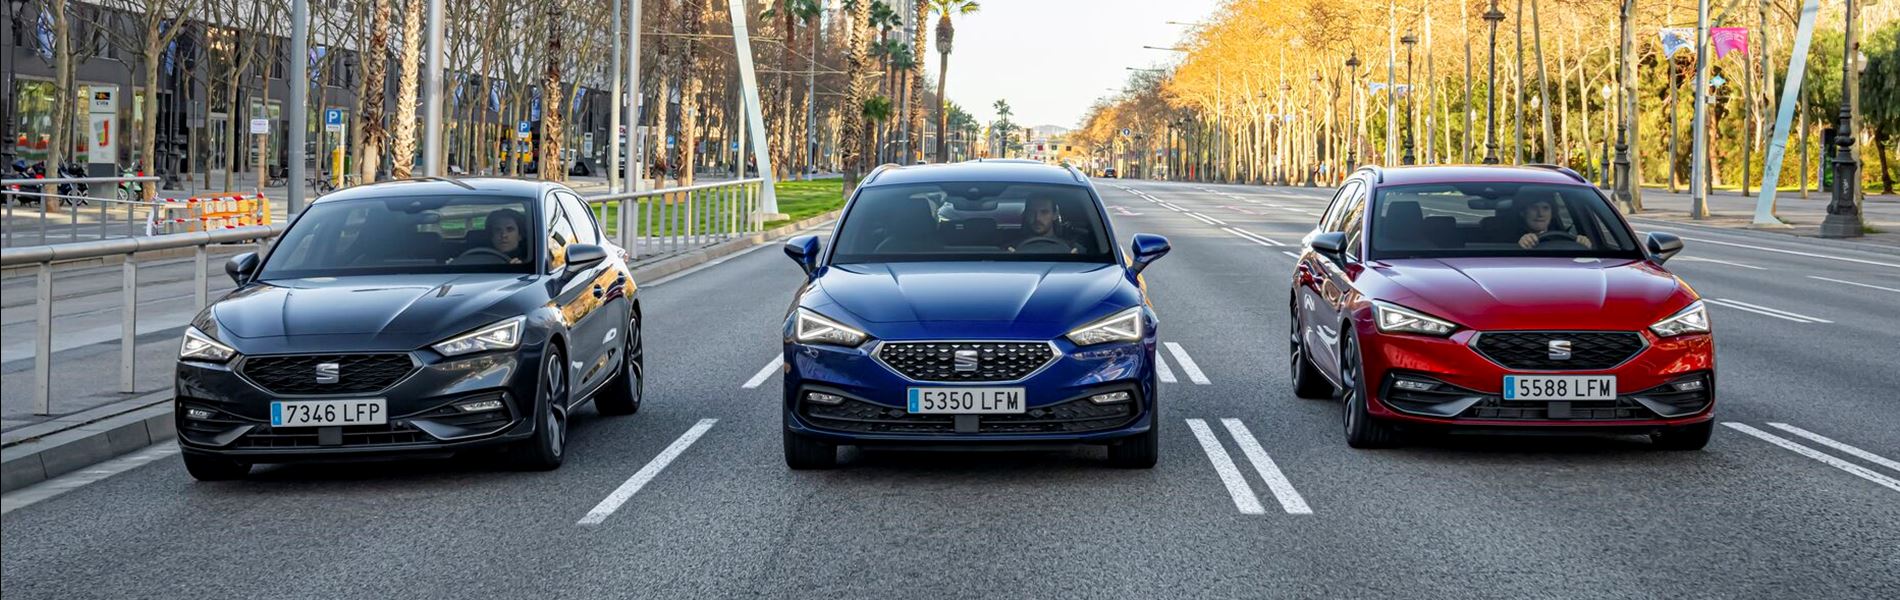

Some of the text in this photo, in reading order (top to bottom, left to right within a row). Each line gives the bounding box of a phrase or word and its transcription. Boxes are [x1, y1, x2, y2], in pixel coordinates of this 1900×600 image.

[329, 111, 338, 123] P
[520, 122, 528, 131] P
[1519, 379, 1610, 397] 5588 LFM
[923, 391, 1019, 410] 5350 LFM
[286, 403, 380, 424] 7346 LFP
